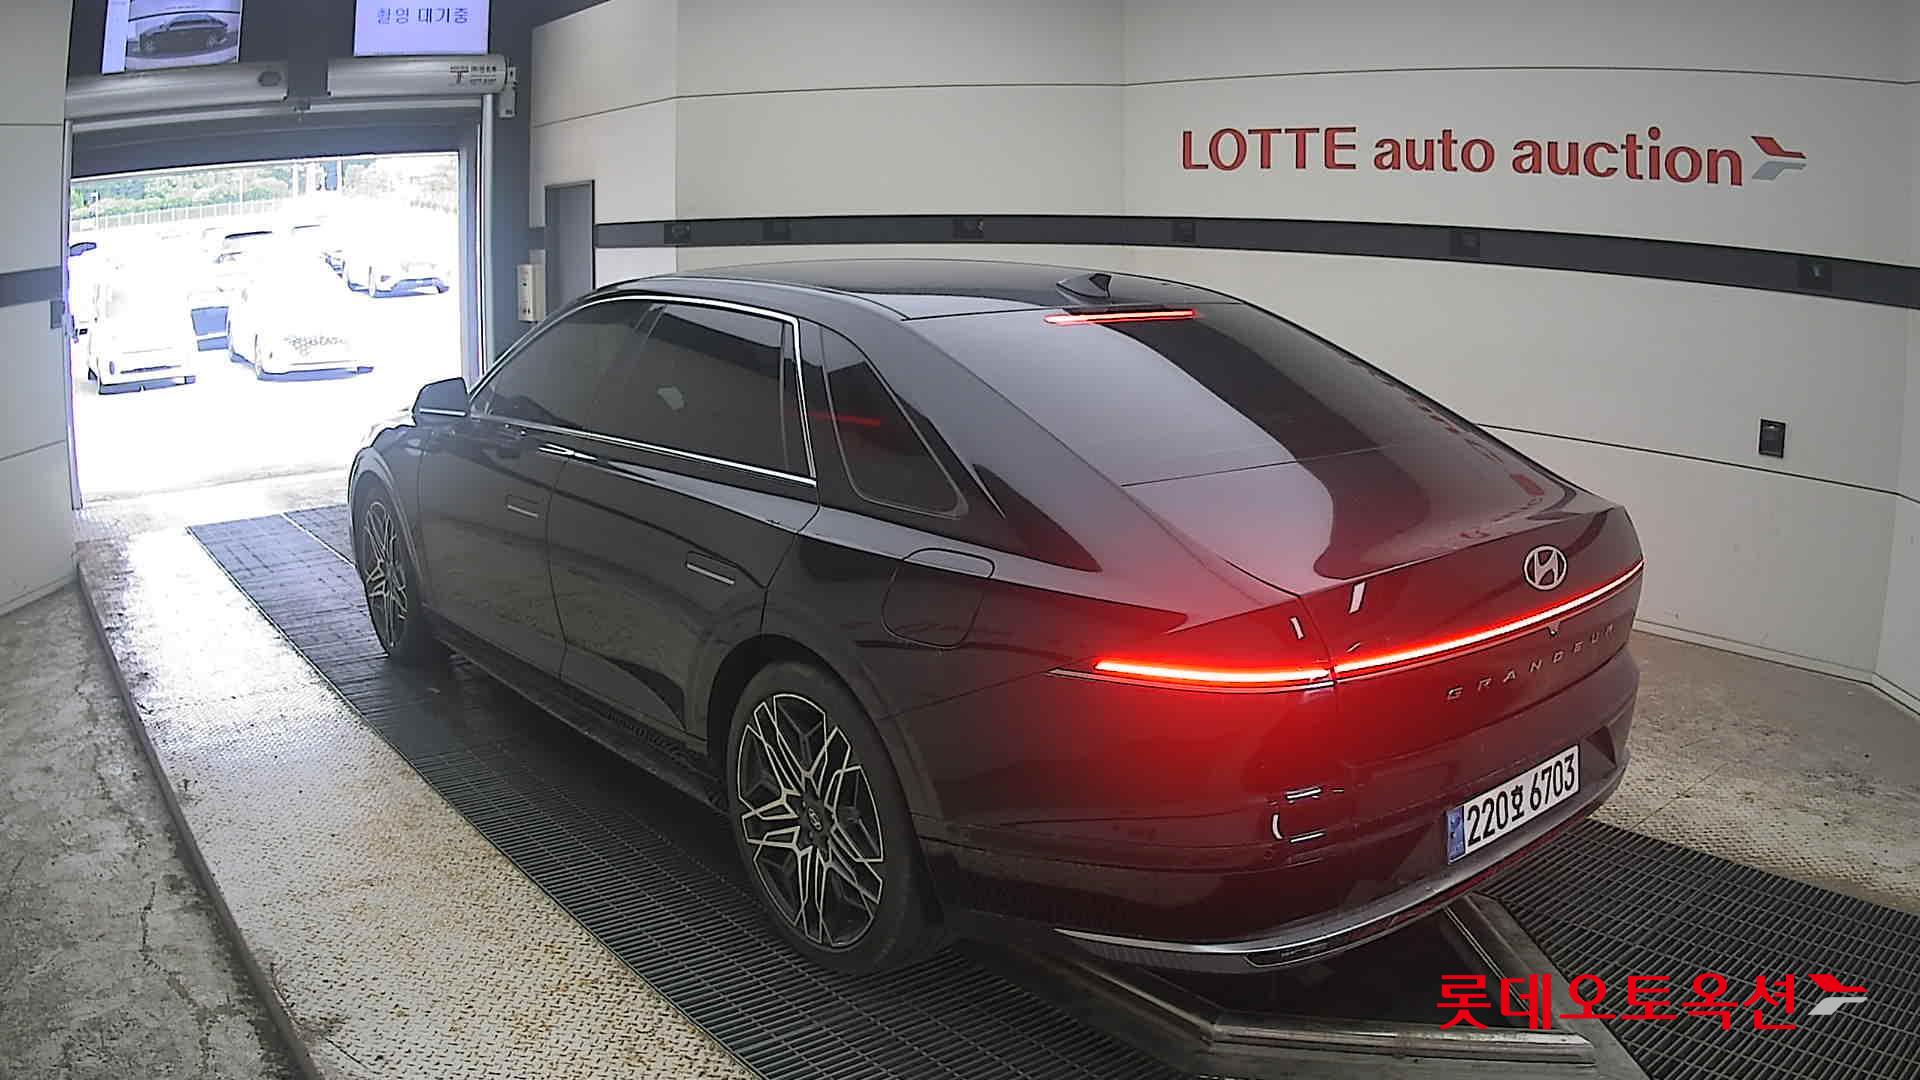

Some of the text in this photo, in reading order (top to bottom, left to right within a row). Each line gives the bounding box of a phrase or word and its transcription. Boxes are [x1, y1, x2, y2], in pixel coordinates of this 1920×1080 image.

[418, 8, 469, 24] 대기중
[1182, 126, 1744, 186] LOTTE auto auction
[1530, 753, 1575, 811] 6703
